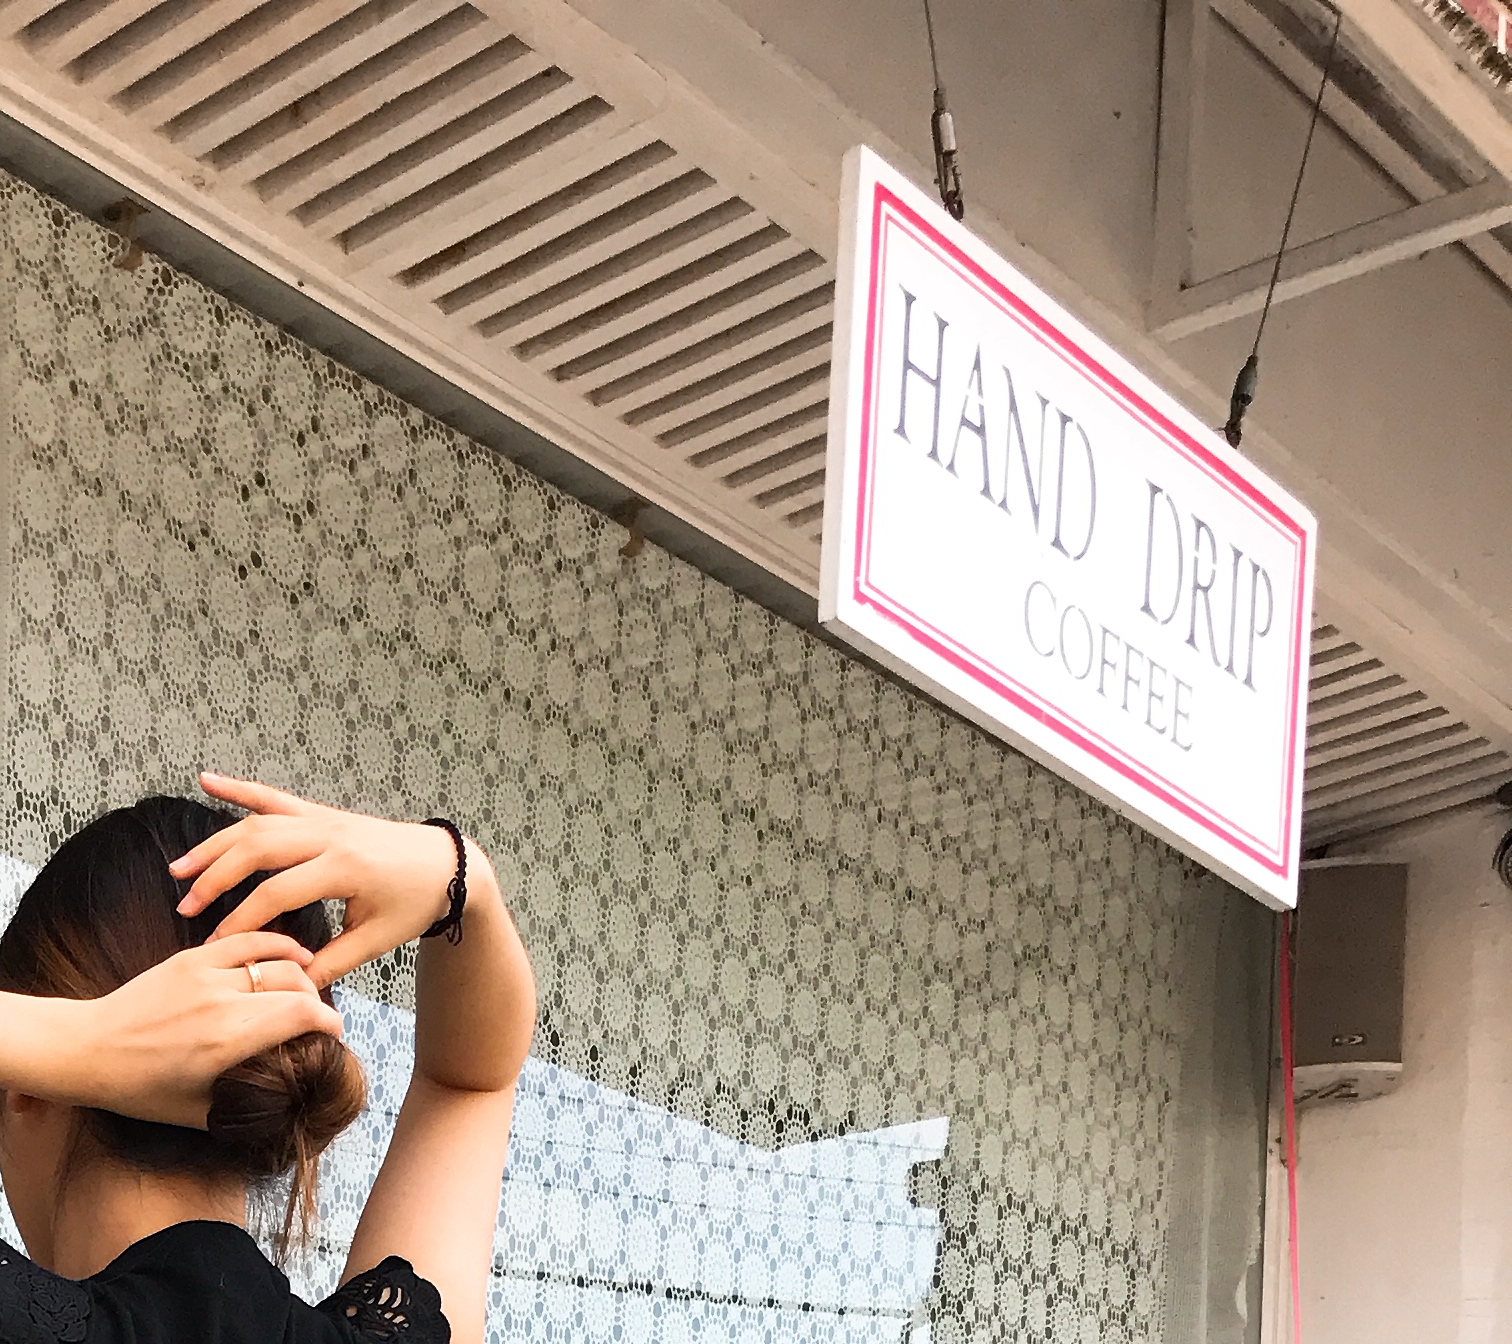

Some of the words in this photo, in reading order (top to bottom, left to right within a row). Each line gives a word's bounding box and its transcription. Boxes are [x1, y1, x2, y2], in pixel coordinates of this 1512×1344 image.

[893, 283, 1098, 564] HAND
[1140, 478, 1275, 693] DRIP
[1024, 580, 1194, 753] COFFEE
